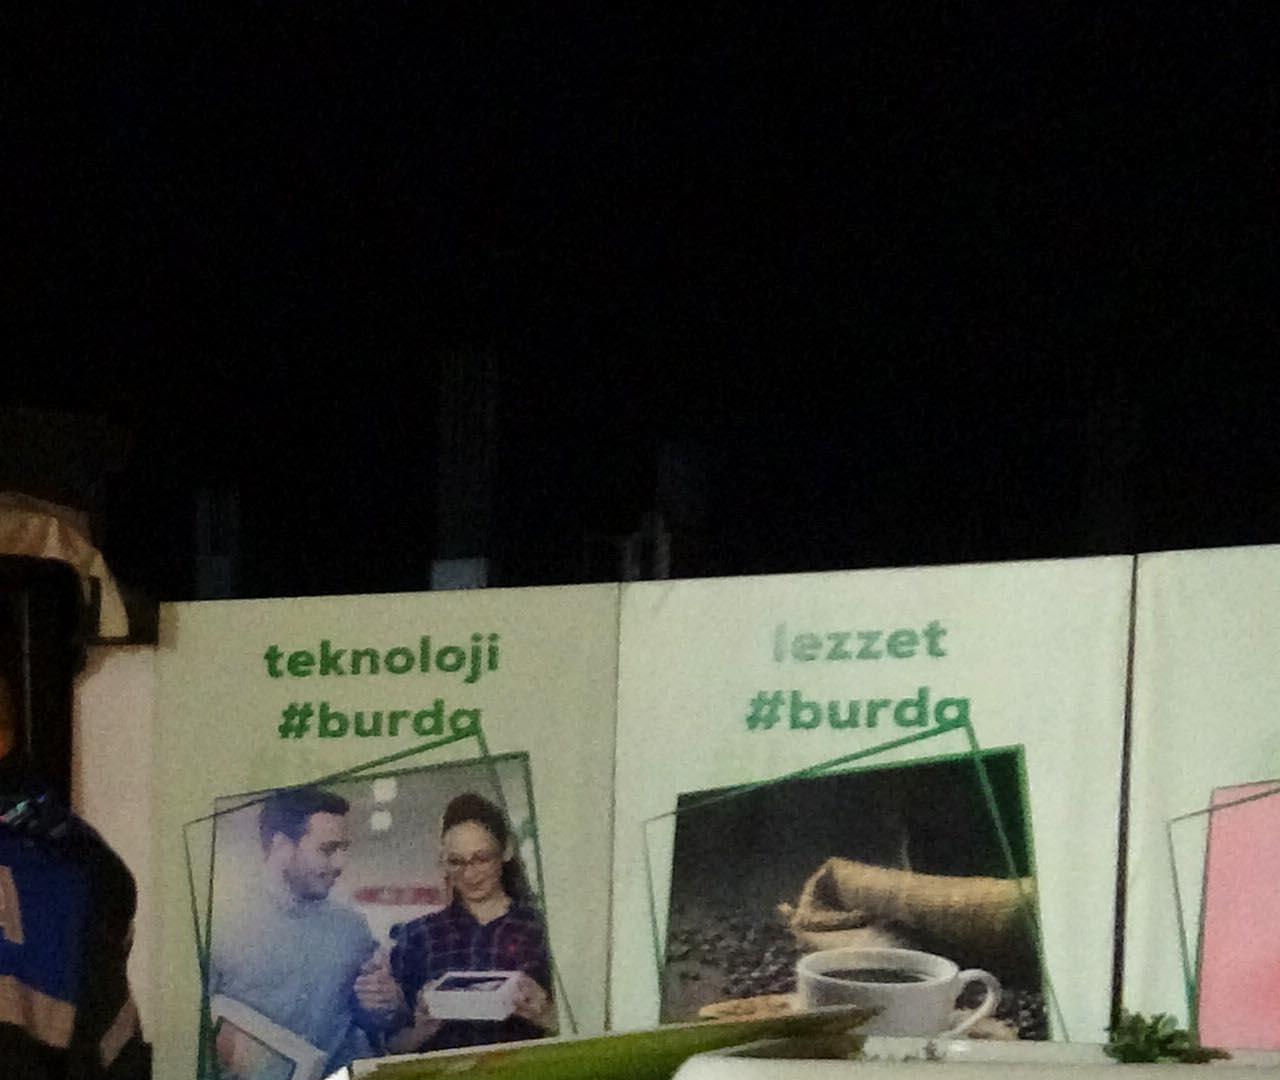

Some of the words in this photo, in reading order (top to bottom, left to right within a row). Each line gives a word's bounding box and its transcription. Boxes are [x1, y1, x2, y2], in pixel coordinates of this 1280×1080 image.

[263, 632, 500, 684] teknoloji
[770, 619, 948, 664] lezzet
[277, 697, 482, 740] #burda
[745, 686, 971, 731] #burda
